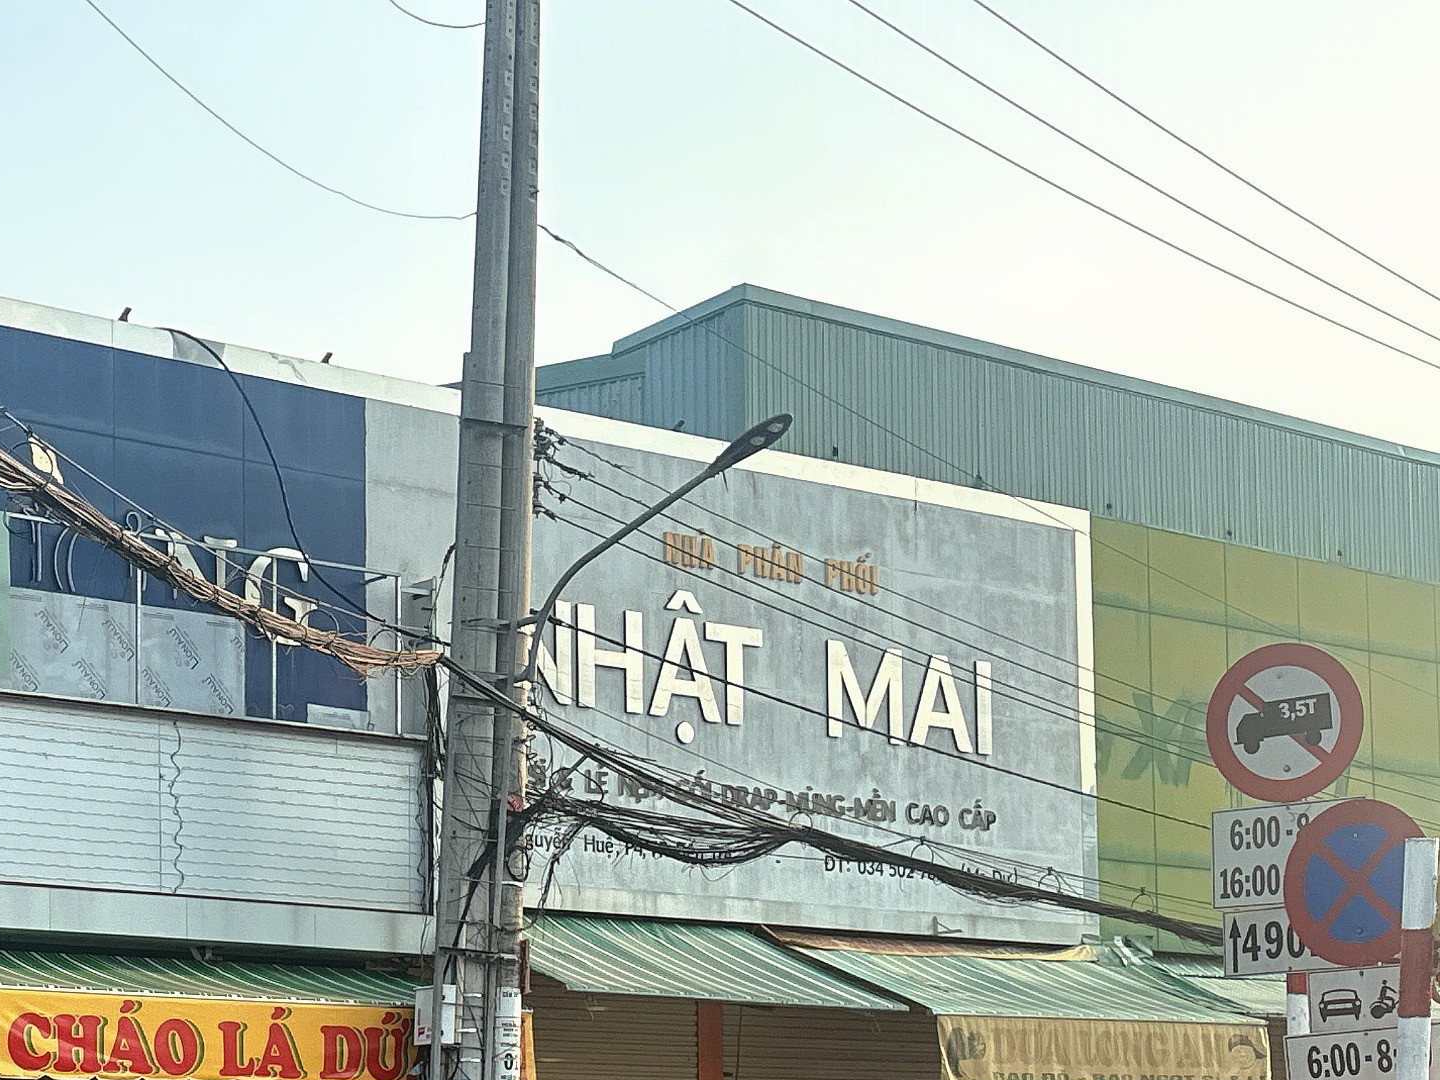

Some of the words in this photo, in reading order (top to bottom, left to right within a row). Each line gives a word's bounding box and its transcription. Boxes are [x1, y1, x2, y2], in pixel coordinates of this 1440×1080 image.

[663, 528, 715, 569] NHÀ
[737, 541, 804, 584] PHÂN
[824, 552, 879, 595] PHỐI
[527, 590, 763, 745] NHẬT
[826, 640, 992, 755] MAI
[1278, 698, 1317, 722] 3,5T
[905, 802, 950, 828] CAO
[958, 798, 997, 832] CẤP
[1220, 864, 1280, 899] 16:00
[7, 1000, 205, 1077] CHÁO
[218, 1006, 308, 1080] LÁ
